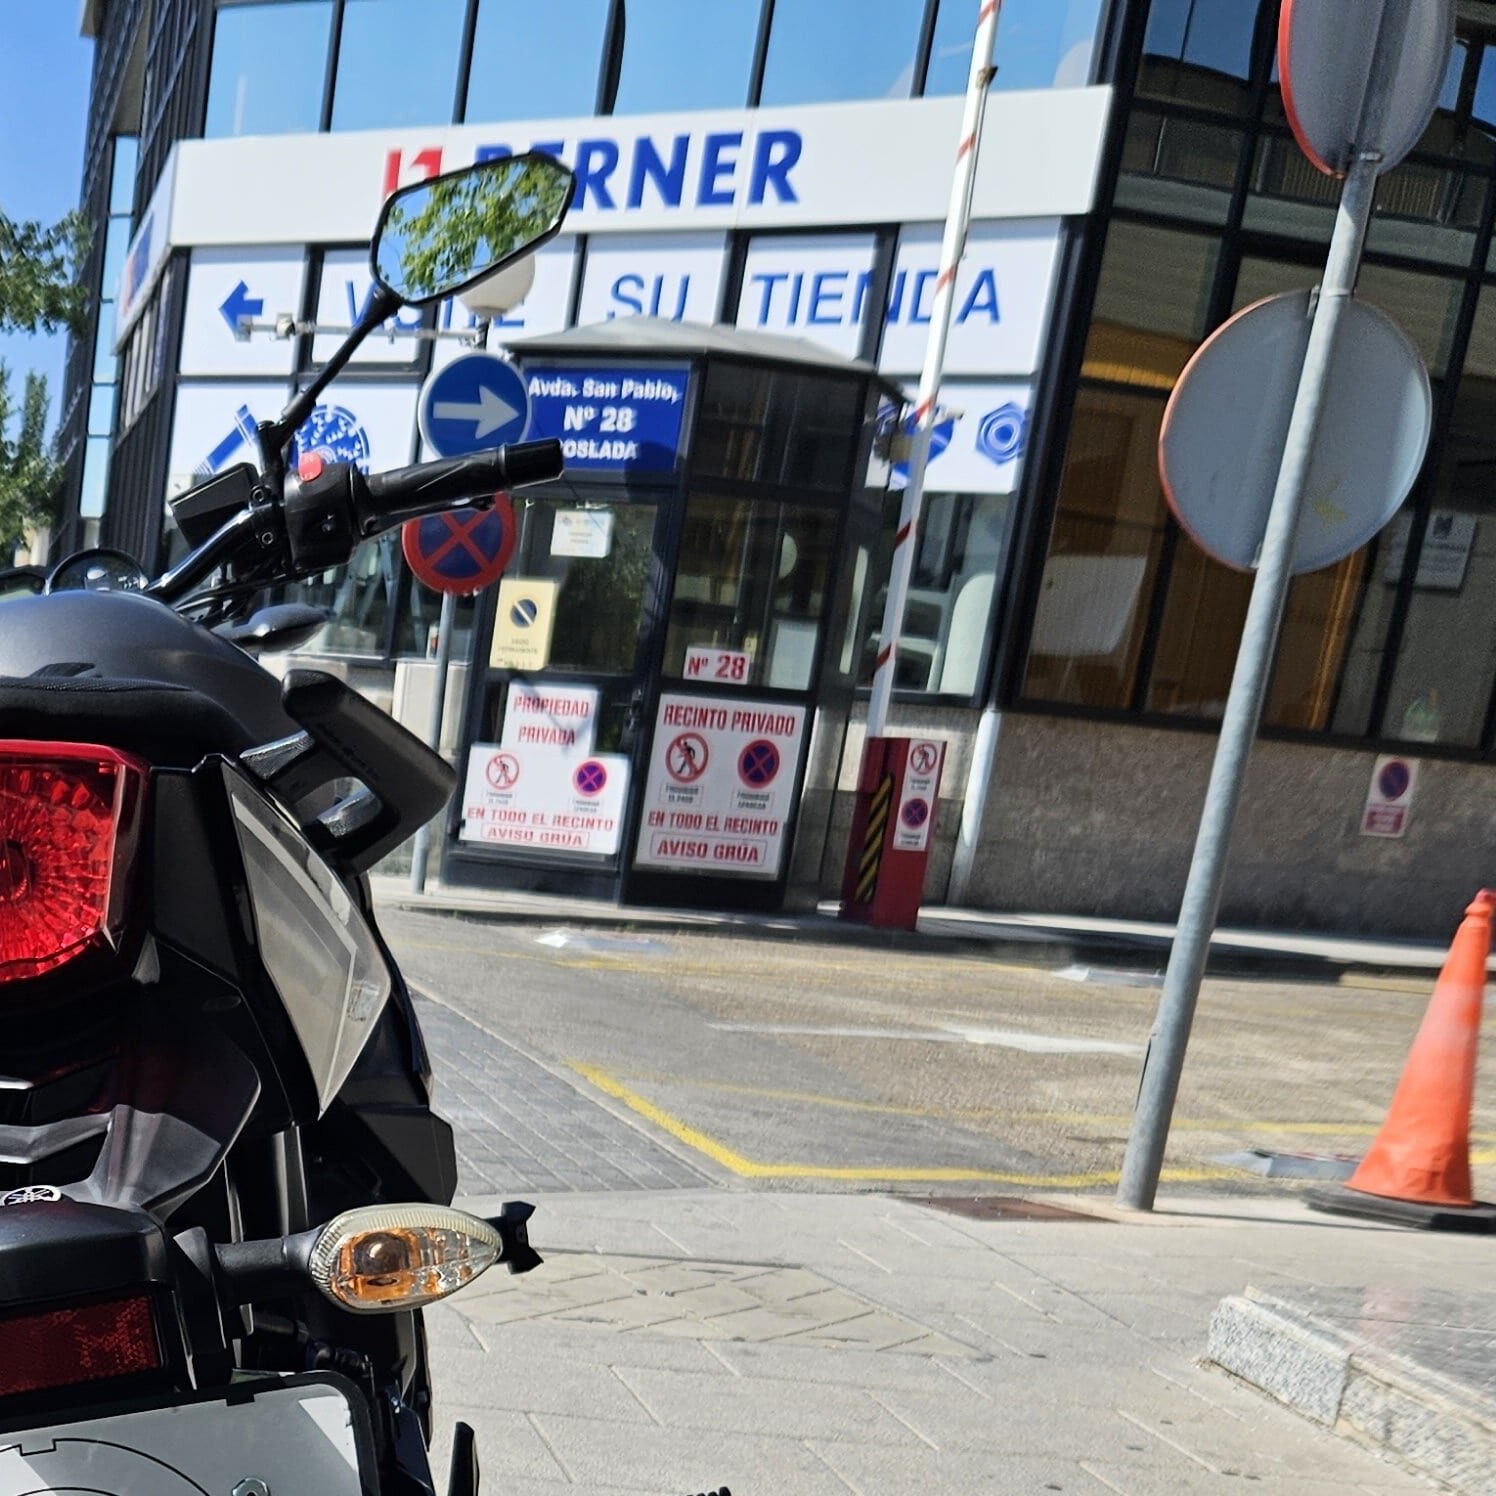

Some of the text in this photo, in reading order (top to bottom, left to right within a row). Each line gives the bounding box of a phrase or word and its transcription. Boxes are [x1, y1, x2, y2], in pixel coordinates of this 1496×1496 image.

[474, 128, 803, 211] RNER
[606, 272, 691, 322] SU
[529, 376, 681, 405] Avda. San Pablo,
[600, 406, 637, 432] 28
[561, 438, 639, 461] OSLADA
[715, 654, 746, 680] 28
[513, 695, 591, 719] PROPIEDAD
[663, 703, 796, 737] RECINTO PRIVADO
[517, 725, 576, 747] PRIVADA
[467, 807, 614, 832] EN TODO EL RECINTO
[648, 810, 778, 836] EN TODO EL RECINTO
[488, 826, 535, 842] AVISO
[657, 838, 709, 858] AVISO
